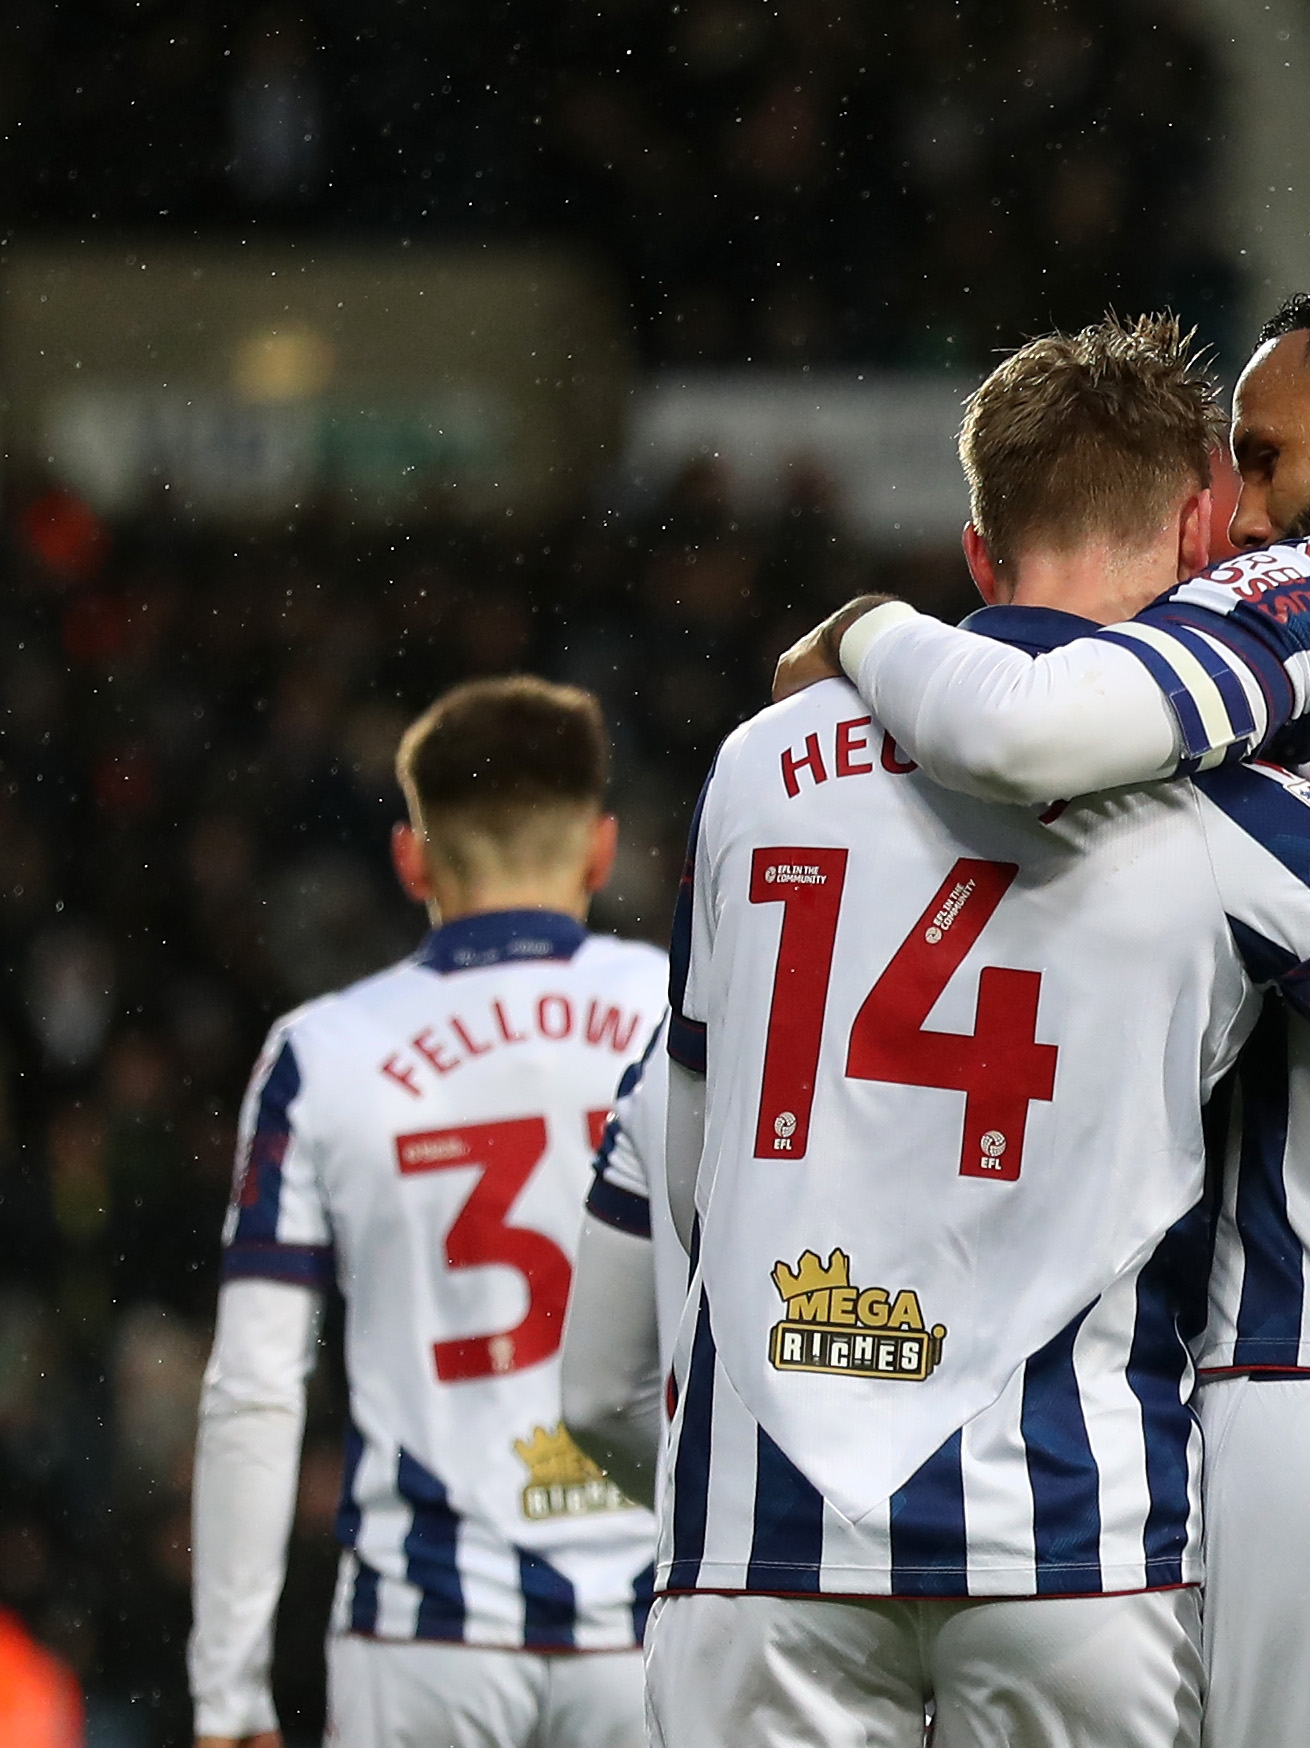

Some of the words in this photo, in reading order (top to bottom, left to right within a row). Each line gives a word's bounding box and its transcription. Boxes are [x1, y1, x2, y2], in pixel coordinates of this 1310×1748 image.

[776, 874, 828, 885] COMMUNITY
[777, 865, 791, 874] EFL
[793, 865, 803, 875] IN
[804, 865, 820, 875] THE
[933, 910, 948, 926] EFL
[942, 898, 954, 911] IN
[949, 882, 965, 900] THE
[940, 878, 977, 931] COMMUNITY
[749, 846, 1059, 1182] 14
[379, 996, 640, 1099] FELLOW
[773, 1138, 792, 1151] EFL
[980, 1156, 1001, 1171] EFL
[395, 1110, 612, 1387] 3
[788, 1287, 923, 1330] MEGA
[783, 1332, 920, 1371] RICHES
